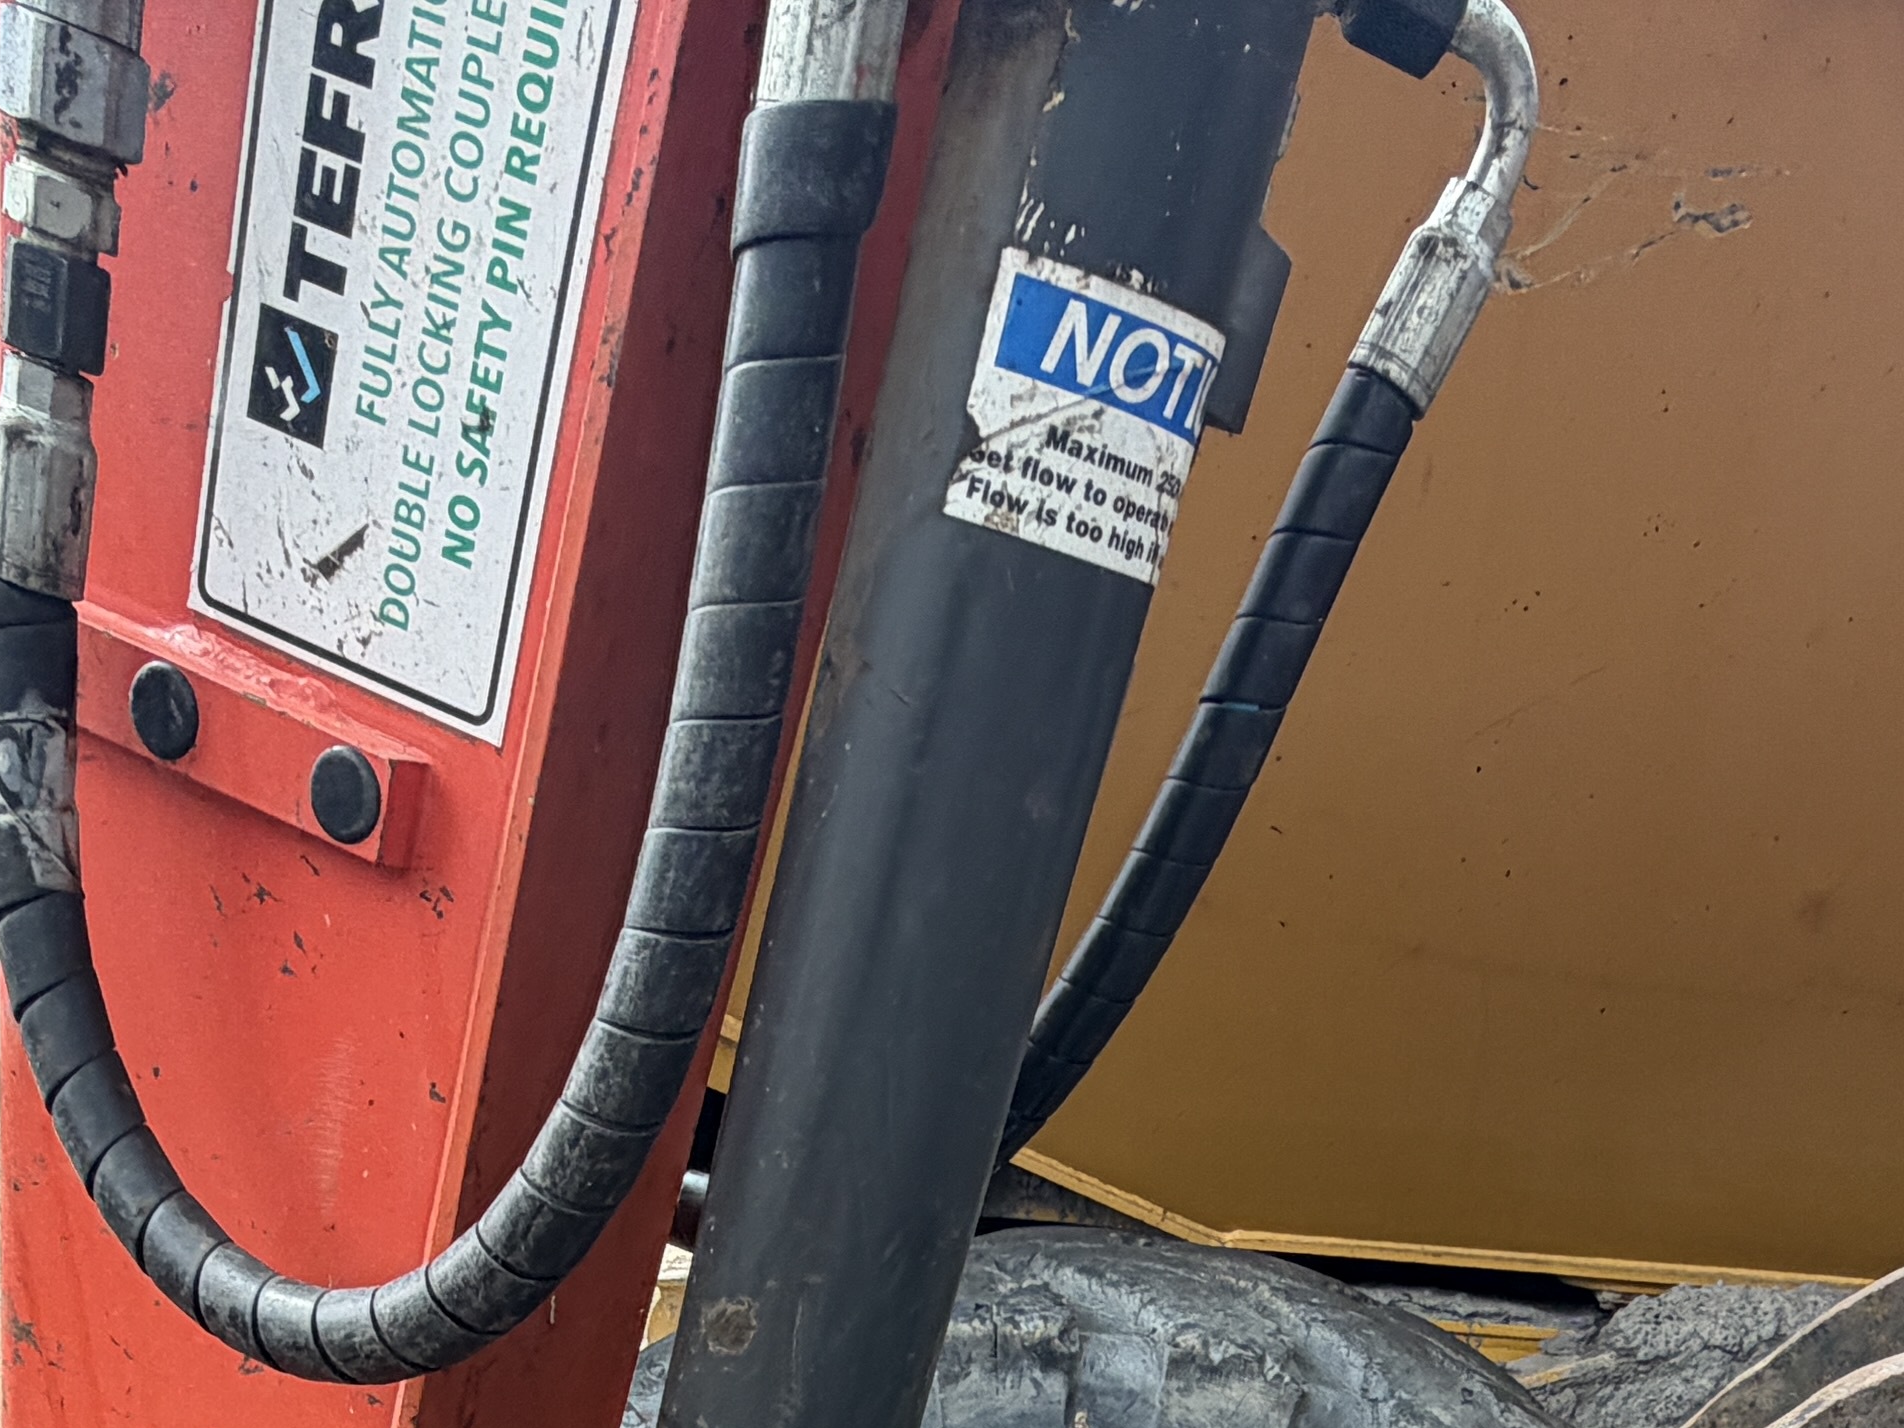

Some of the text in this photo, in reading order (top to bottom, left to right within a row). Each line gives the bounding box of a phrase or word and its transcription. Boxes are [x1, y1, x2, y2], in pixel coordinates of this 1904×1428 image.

[284, 0, 386, 307] TEFR
[355, 0, 449, 428] FULLY AUTOMATI
[442, 0, 568, 572] NO SAFETY PIN REQUI
[380, 443, 435, 632] DOUBLE
[408, 221, 472, 439] LOCKING
[966, 474, 1029, 514] Flow
[1066, 511, 1103, 543] too
[1108, 526, 1144, 560] high
[1021, 456, 1077, 495] flow
[1084, 478, 1106, 506] to
[1045, 424, 1154, 487] Maximum
